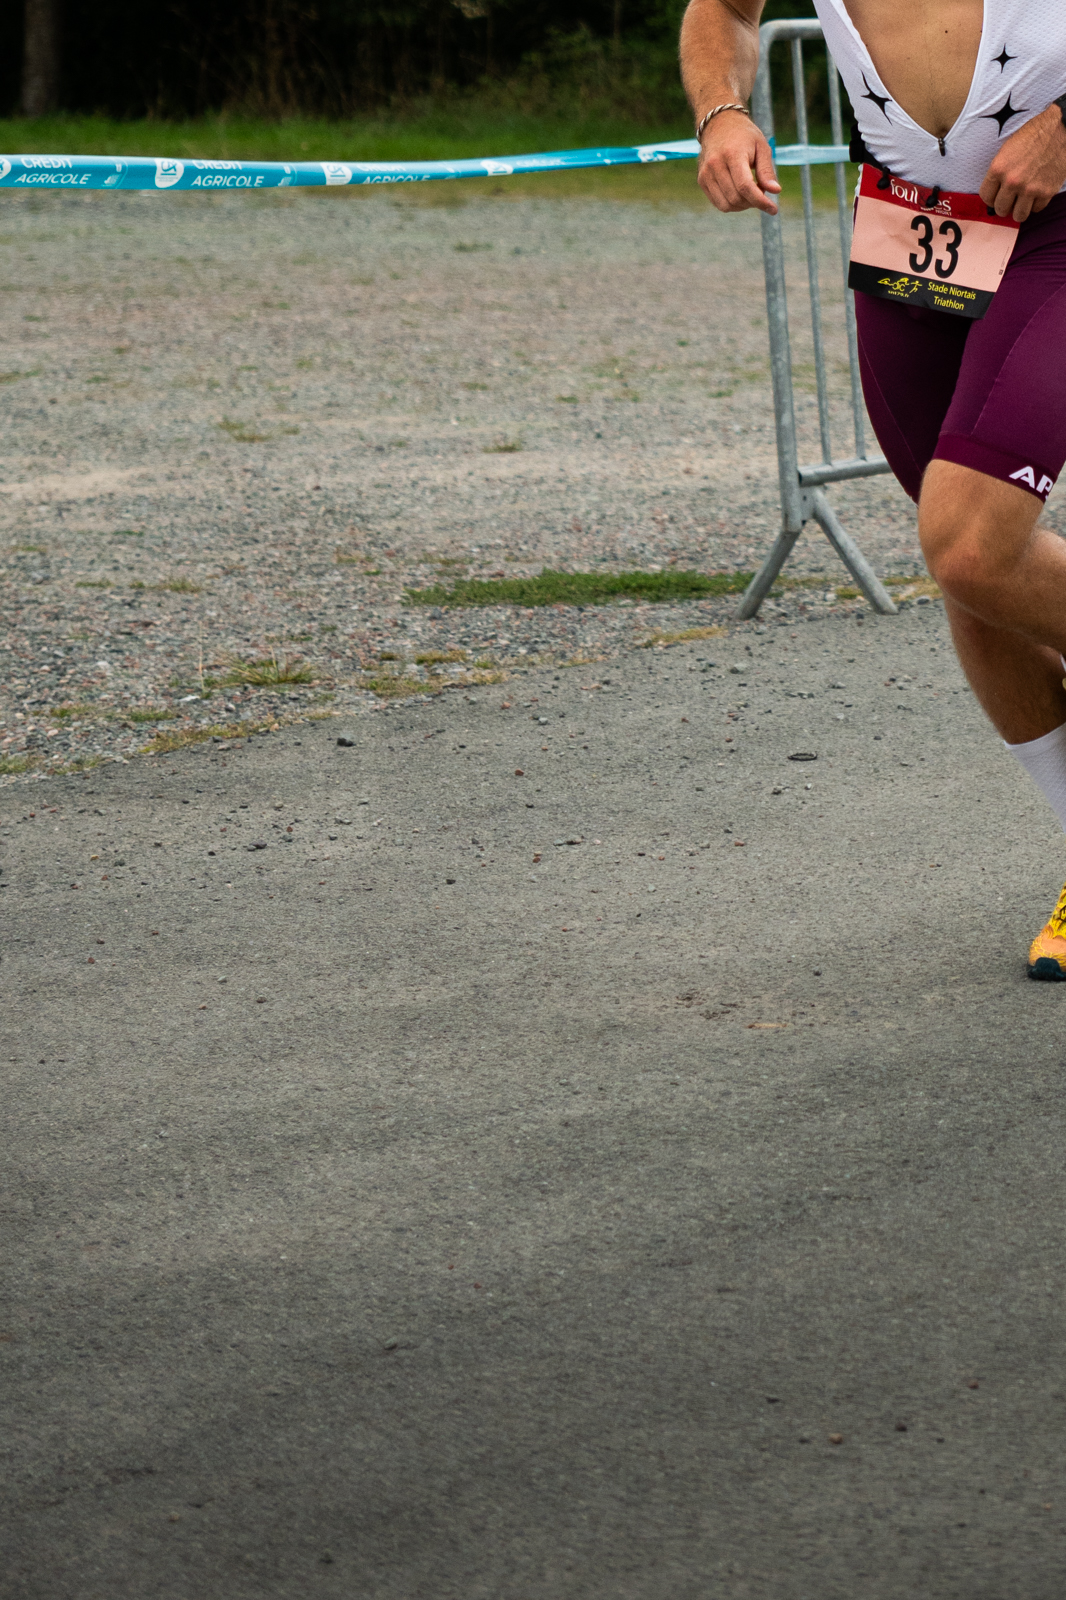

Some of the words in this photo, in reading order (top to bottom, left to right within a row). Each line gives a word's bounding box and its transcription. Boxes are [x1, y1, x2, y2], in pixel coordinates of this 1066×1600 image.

[14, 173, 92, 185] AGRICOLE
[190, 175, 265, 187] AGRICOLE
[361, 174, 431, 184] AGRICOLE
[909, 215, 963, 279] 33
[927, 281, 949, 294] Stade
[949, 286, 977, 300] Niortais
[933, 296, 965, 311] Triathlon
